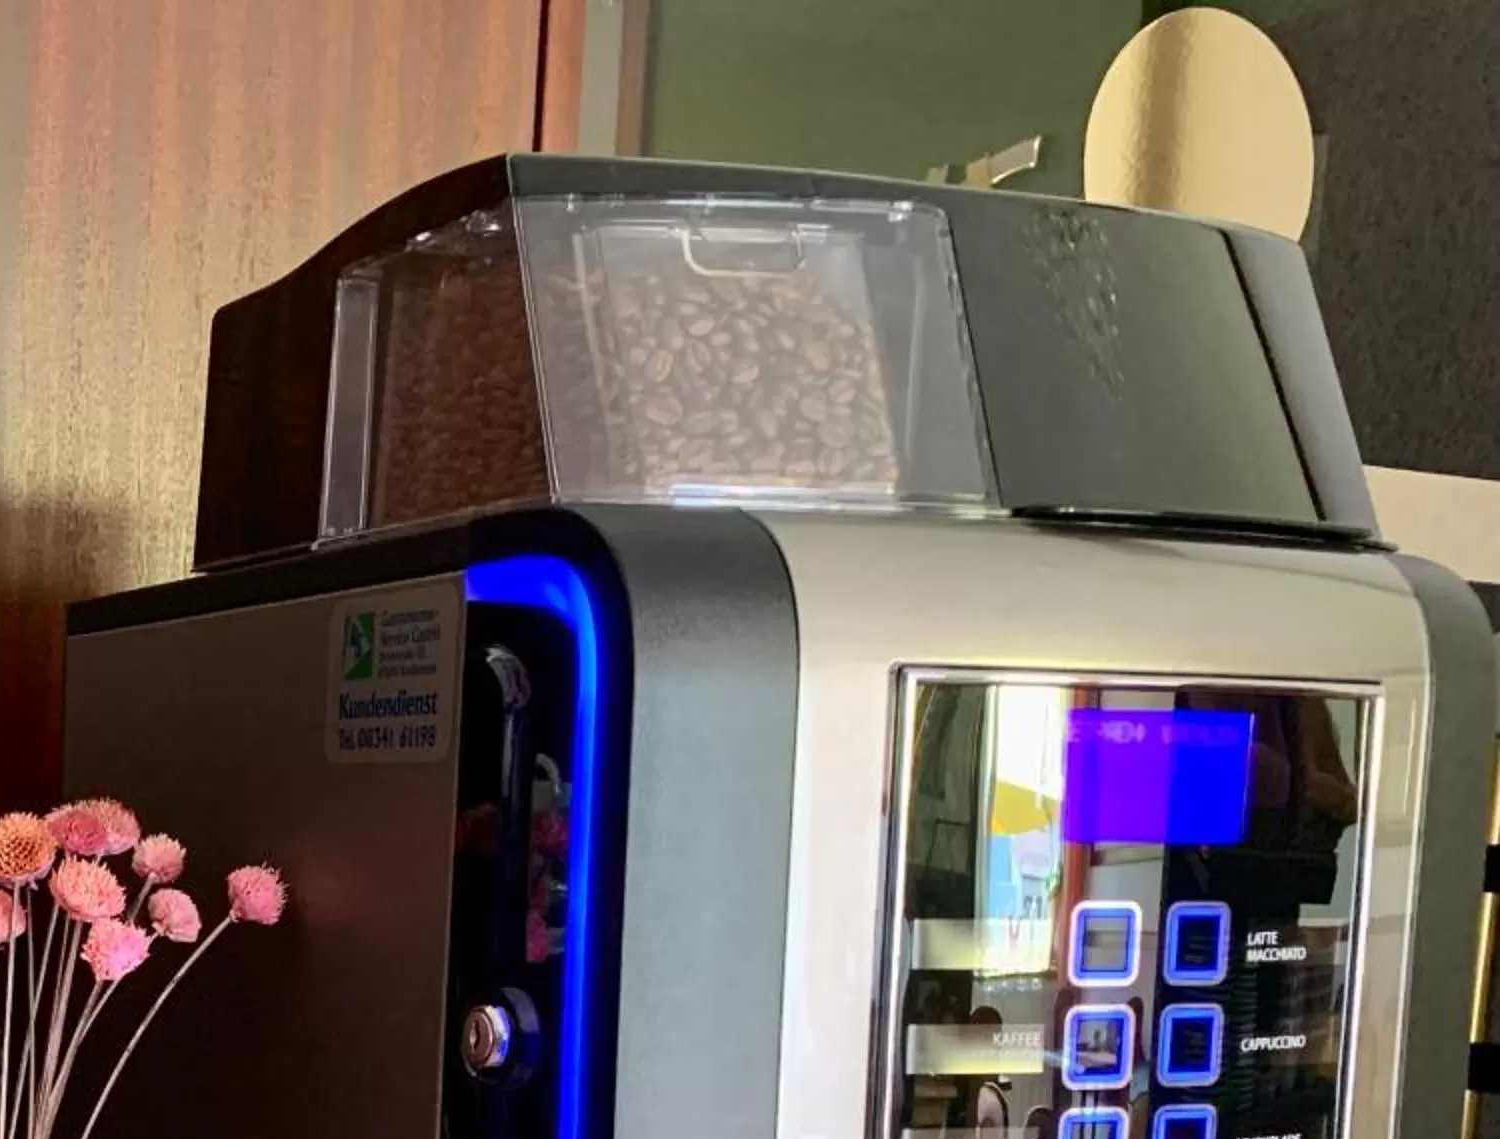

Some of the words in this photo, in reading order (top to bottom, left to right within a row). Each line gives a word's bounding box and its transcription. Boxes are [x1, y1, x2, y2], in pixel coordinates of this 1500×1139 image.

[338, 687, 439, 721] Kundendienst
[1246, 930, 1280, 947] LATTE
[992, 1030, 1042, 1048] KAFFEE
